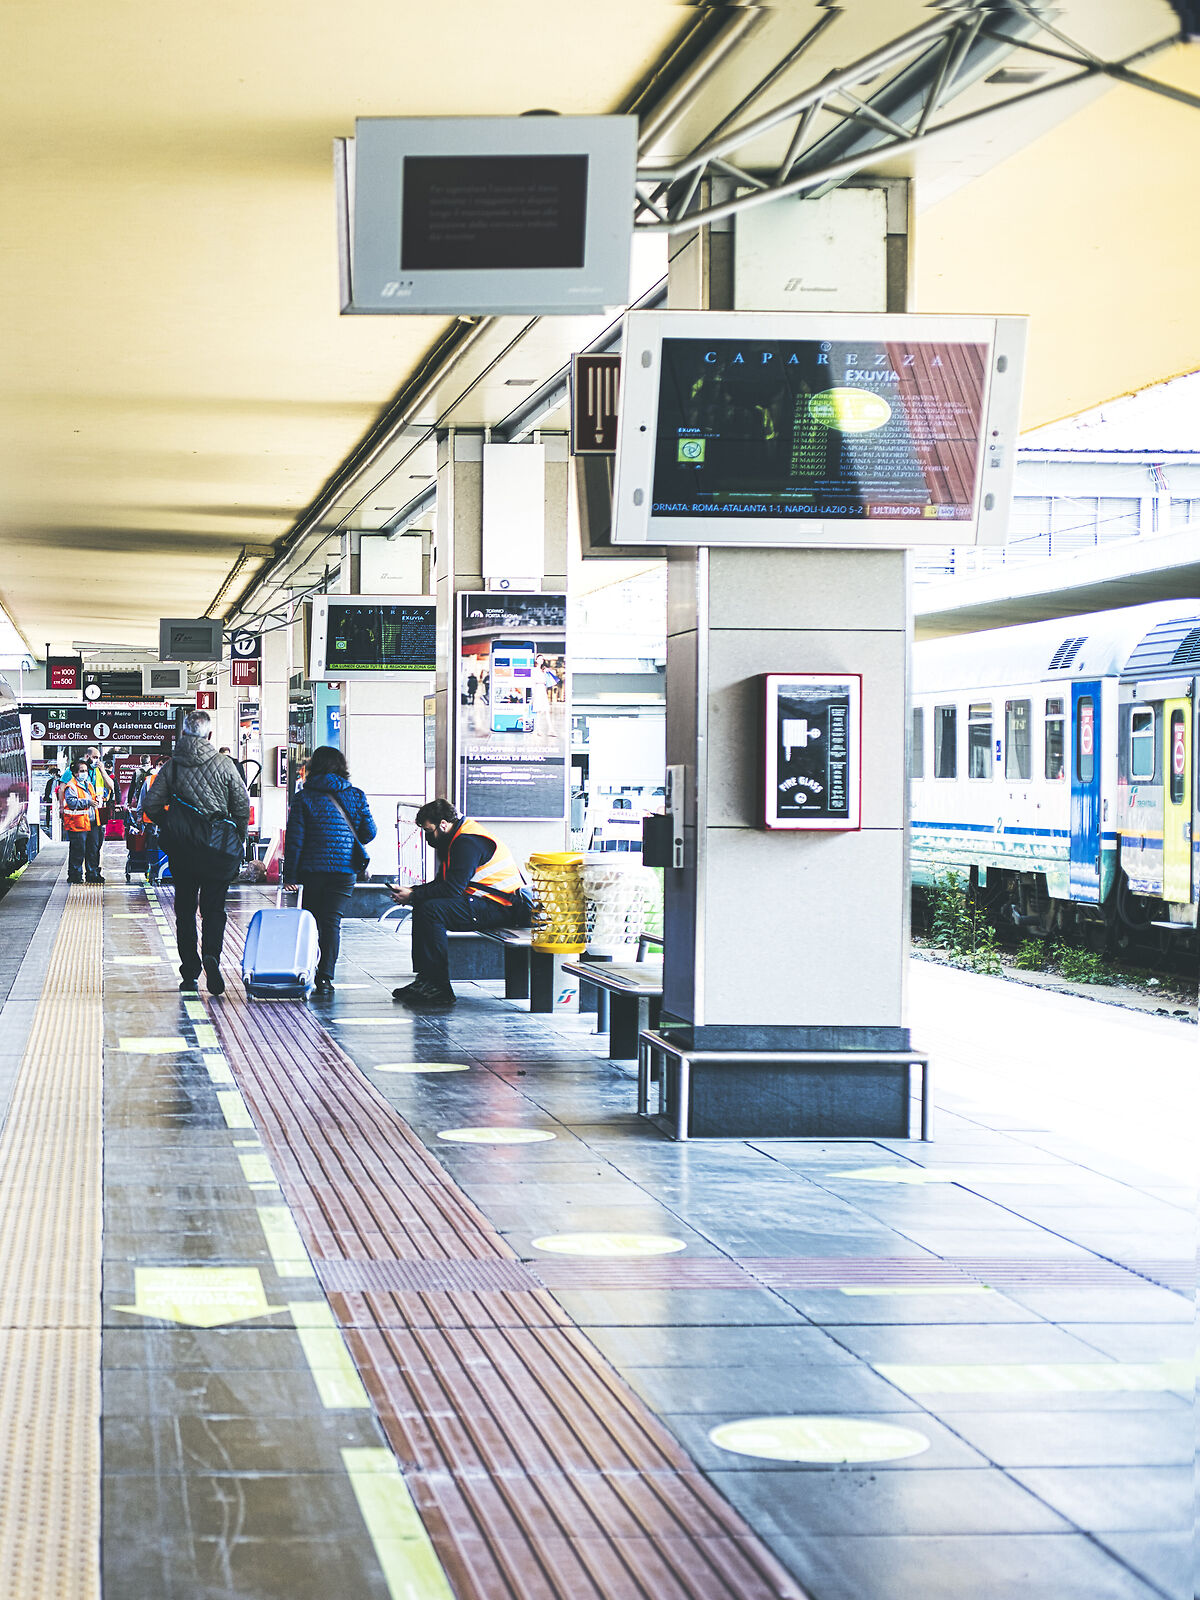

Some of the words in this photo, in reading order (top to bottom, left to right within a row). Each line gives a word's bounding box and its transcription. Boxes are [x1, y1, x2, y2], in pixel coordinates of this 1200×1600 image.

[704, 352, 944, 367] CAPAREZZA
[845, 369, 901, 382] EXUVIA
[692, 503, 767, 512] ROMA-ATALANTA
[784, 504, 848, 514] NAPOLI-LAZIO
[849, 505, 864, 514] 5-2
[239, 640, 253, 650] 17
[48, 722, 91, 730] Biglietteria
[112, 722, 152, 730] Assistenza
[778, 777, 798, 792] FIRE
[798, 776, 824, 793] GLASS
[997, 817, 1002, 833] 2
